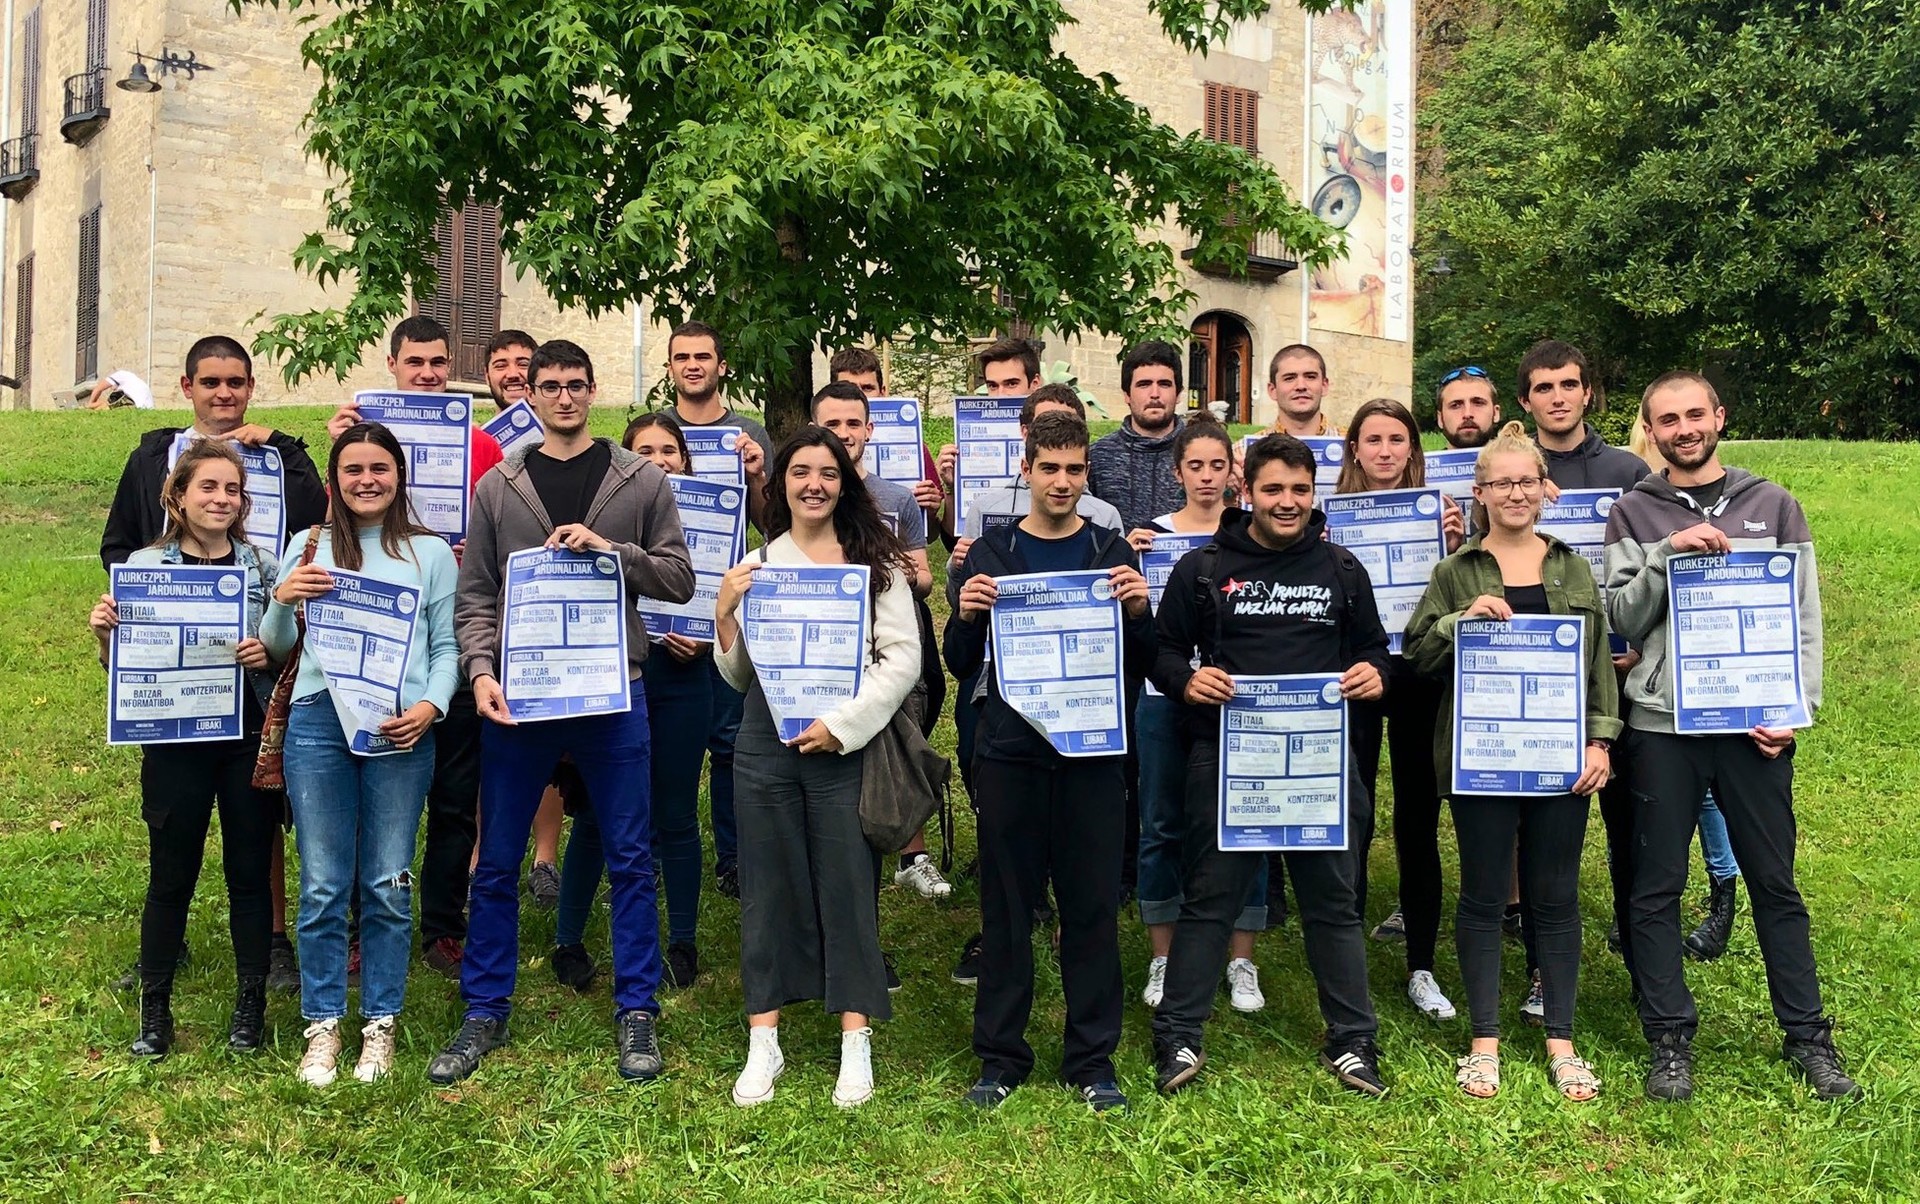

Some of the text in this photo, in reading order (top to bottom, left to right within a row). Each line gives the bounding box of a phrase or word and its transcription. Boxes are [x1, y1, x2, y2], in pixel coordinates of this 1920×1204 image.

[1390, 102, 1405, 320] LABORATORIUM
[359, 396, 405, 407] AURKEZPEN
[959, 401, 998, 409] AURKEZPEN
[383, 408, 442, 420] JARDUNALDIAK
[870, 413, 898, 422] NALDIAK
[972, 426, 988, 434] ITAIA
[1425, 465, 1475, 478] ARDUNALDIAK
[674, 492, 716, 507] DUNALDIAK
[1328, 498, 1375, 511] AURKEZPEN
[425, 503, 460, 513] TZERTUAK
[1354, 506, 1413, 520] JARDUNALDIAK
[986, 516, 1015, 524] AURKEZ
[1345, 529, 1363, 539] ITAIA
[706, 545, 721, 554] LANA
[1413, 555, 1429, 563] LANA
[1674, 555, 1727, 571] AURKEZPEN
[534, 563, 593, 576] JARDUNALDIAK
[1704, 567, 1765, 581] JARDUNALDIAK
[117, 572, 172, 583] AURKEZPEN
[332, 575, 361, 592] KEZPEN
[997, 581, 1048, 595] AURKEZPEN
[147, 585, 214, 596] JARDUNALDIAK
[776, 583, 838, 595] JARDUNALDIAK
[1272, 582, 1331, 601] IRAULTZA
[338, 590, 394, 611] JARDUNALDIAK
[1026, 591, 1089, 606] JARDUNALDIAK
[1693, 592, 1713, 602] ITAIA
[134, 606, 156, 616] ITAIA
[762, 604, 782, 614] ITAIA
[1287, 601, 1331, 617] GARA!
[323, 609, 344, 621] ITAIA
[590, 616, 606, 624] LANA
[1002, 618, 1013, 627] 22
[1014, 616, 1035, 626] ITAIA
[1766, 622, 1781, 630] LANA
[687, 621, 710, 632] LUBAKI
[1462, 622, 1512, 633] AURKEZPEN
[121, 630, 132, 639] 28
[189, 632, 195, 641] 5
[830, 637, 846, 645] LANA
[1068, 639, 1075, 648] 5
[1489, 634, 1552, 646] JARDUNALDIAK
[1089, 645, 1105, 654] LANA
[1477, 655, 1497, 665] ITAIA
[522, 667, 549, 676] BATZAR
[567, 665, 618, 675] KONTZERTUAK
[510, 676, 561, 686] INFORMATIBOA
[1698, 675, 1726, 685] BATZAR
[1746, 673, 1793, 683] KONTZERTUAK
[181, 685, 233, 696] KONTZERTUAK
[765, 686, 786, 695] ATZAR
[802, 686, 852, 696] KONTZERTUAK
[1233, 683, 1278, 694] URKEZPEN
[1529, 681, 1535, 691] 5
[1685, 685, 1740, 696] INFORMATIBOA
[133, 690, 162, 698] BATZAR
[1549, 689, 1565, 697] LANA
[120, 698, 174, 708] INFORMATIBOA
[1066, 696, 1115, 708] KONTZERTUAK
[1255, 694, 1319, 706] JARDUNALDIAK
[1021, 701, 1049, 710] BATZAR
[1243, 715, 1263, 725] ITAIA
[196, 720, 222, 731] LUBAKI
[1230, 739, 1240, 747] 28
[1294, 739, 1300, 749] 5
[1477, 739, 1504, 747] BATZAR
[1523, 739, 1574, 749] KONTZERTUAK
[1464, 748, 1516, 757] INFORMATIBOA
[1538, 775, 1564, 786] LUBAKI
[1242, 796, 1269, 805] BATZAR
[1287, 793, 1337, 804] KONTZERTUAK
[1230, 805, 1280, 814] INFORMATIBOA
[1302, 829, 1327, 839] LUBAKI
